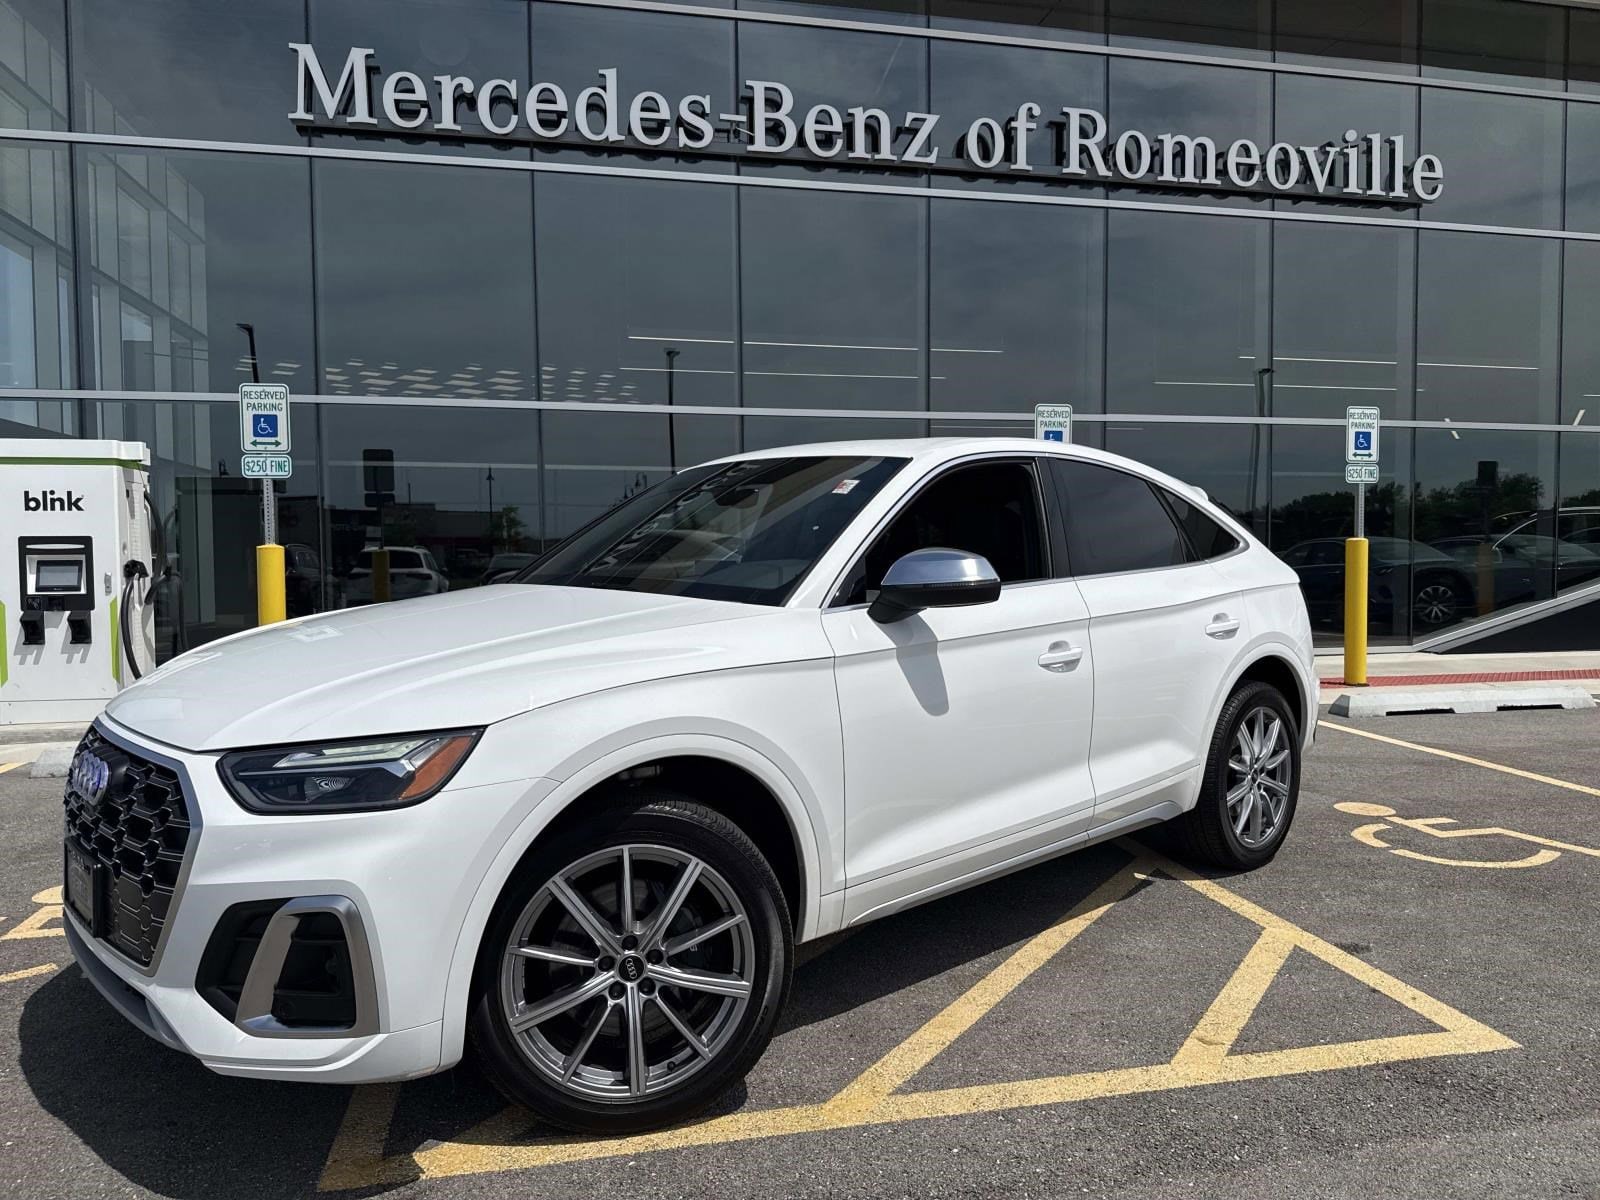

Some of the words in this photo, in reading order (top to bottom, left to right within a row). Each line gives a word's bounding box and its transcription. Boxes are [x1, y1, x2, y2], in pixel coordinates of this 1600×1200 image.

[288, 42, 940, 164] Mercedes-Benz
[966, 102, 1041, 169] of
[1062, 106, 1444, 201] Romeoville
[243, 391, 285, 400] RESERVED
[246, 402, 283, 412] PARKING
[1037, 410, 1069, 418] RESERVED
[1349, 412, 1377, 420] RESERVED
[1351, 422, 1375, 430] PARKING
[245, 460, 267, 473] $250
[270, 461, 288, 473] FINE
[1348, 469, 1363, 479] $250
[1364, 469, 1376, 479] FINE
[24, 490, 84, 512] blink
